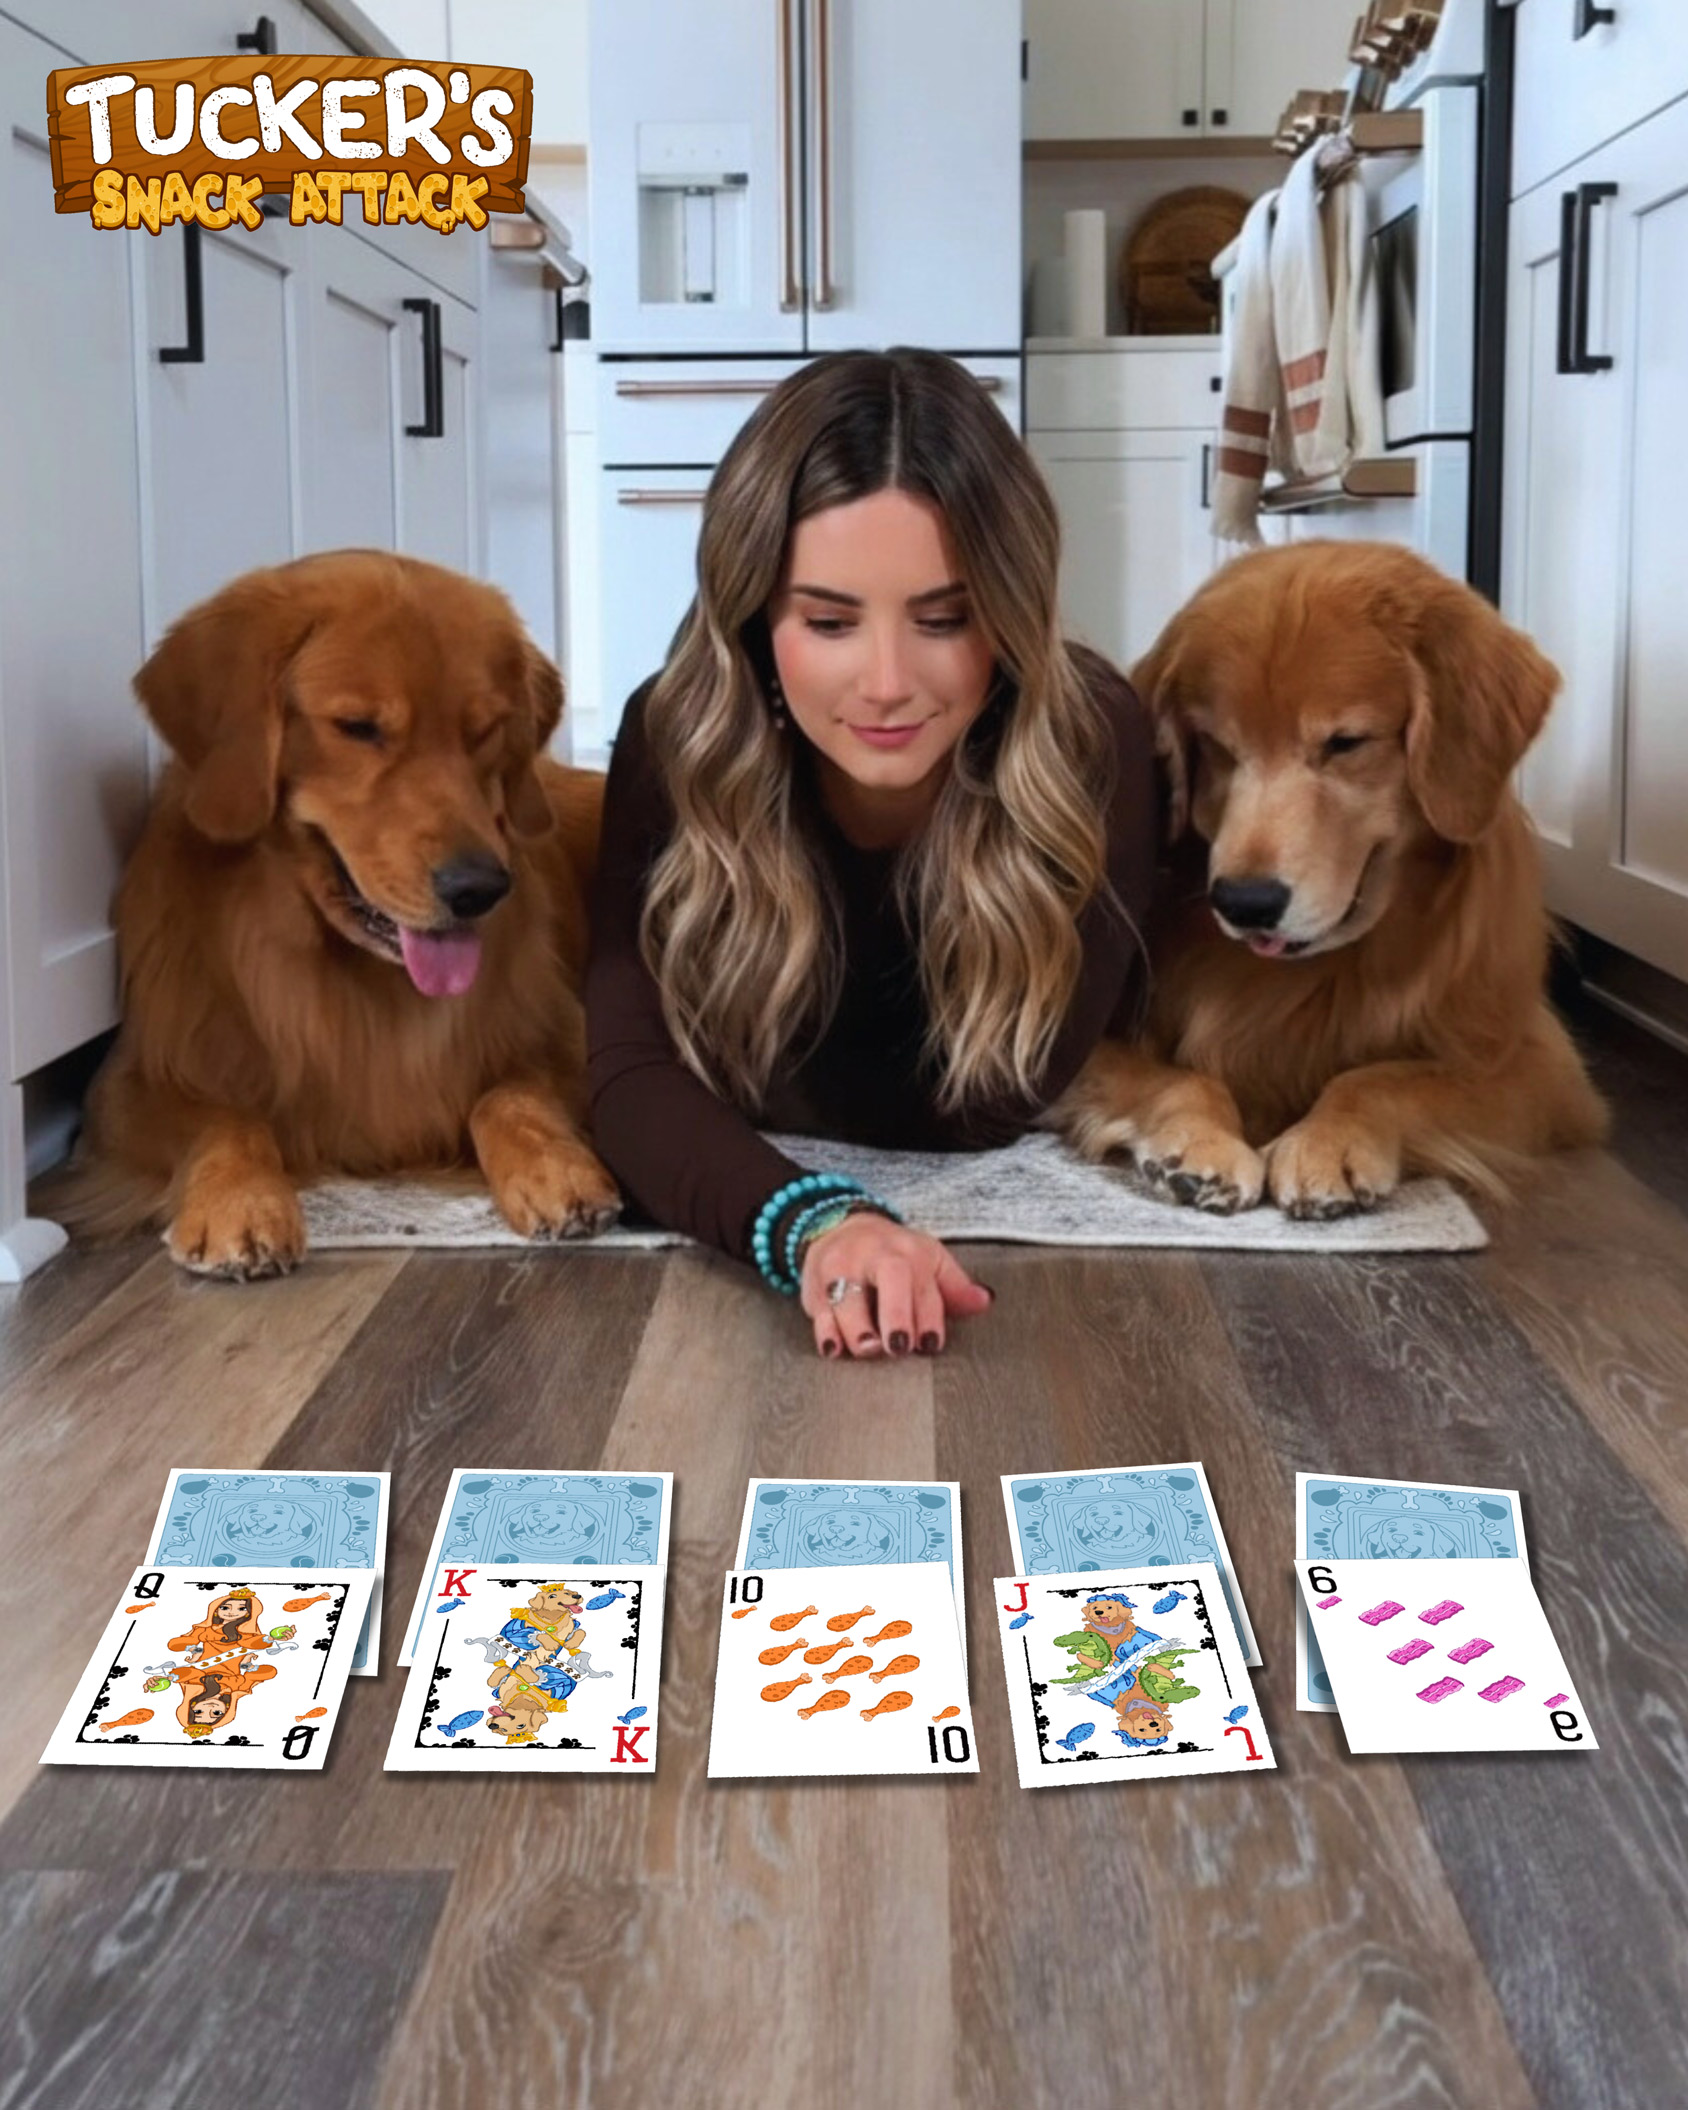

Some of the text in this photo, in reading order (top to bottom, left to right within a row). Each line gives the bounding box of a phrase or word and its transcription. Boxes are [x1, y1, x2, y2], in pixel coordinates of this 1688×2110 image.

[133, 1572, 165, 1599] Q
[437, 1569, 478, 1597] K
[729, 1575, 764, 1604] 10
[1307, 1565, 1338, 1594] 6
[1003, 1582, 1030, 1613] J
[610, 1726, 651, 1764] K
